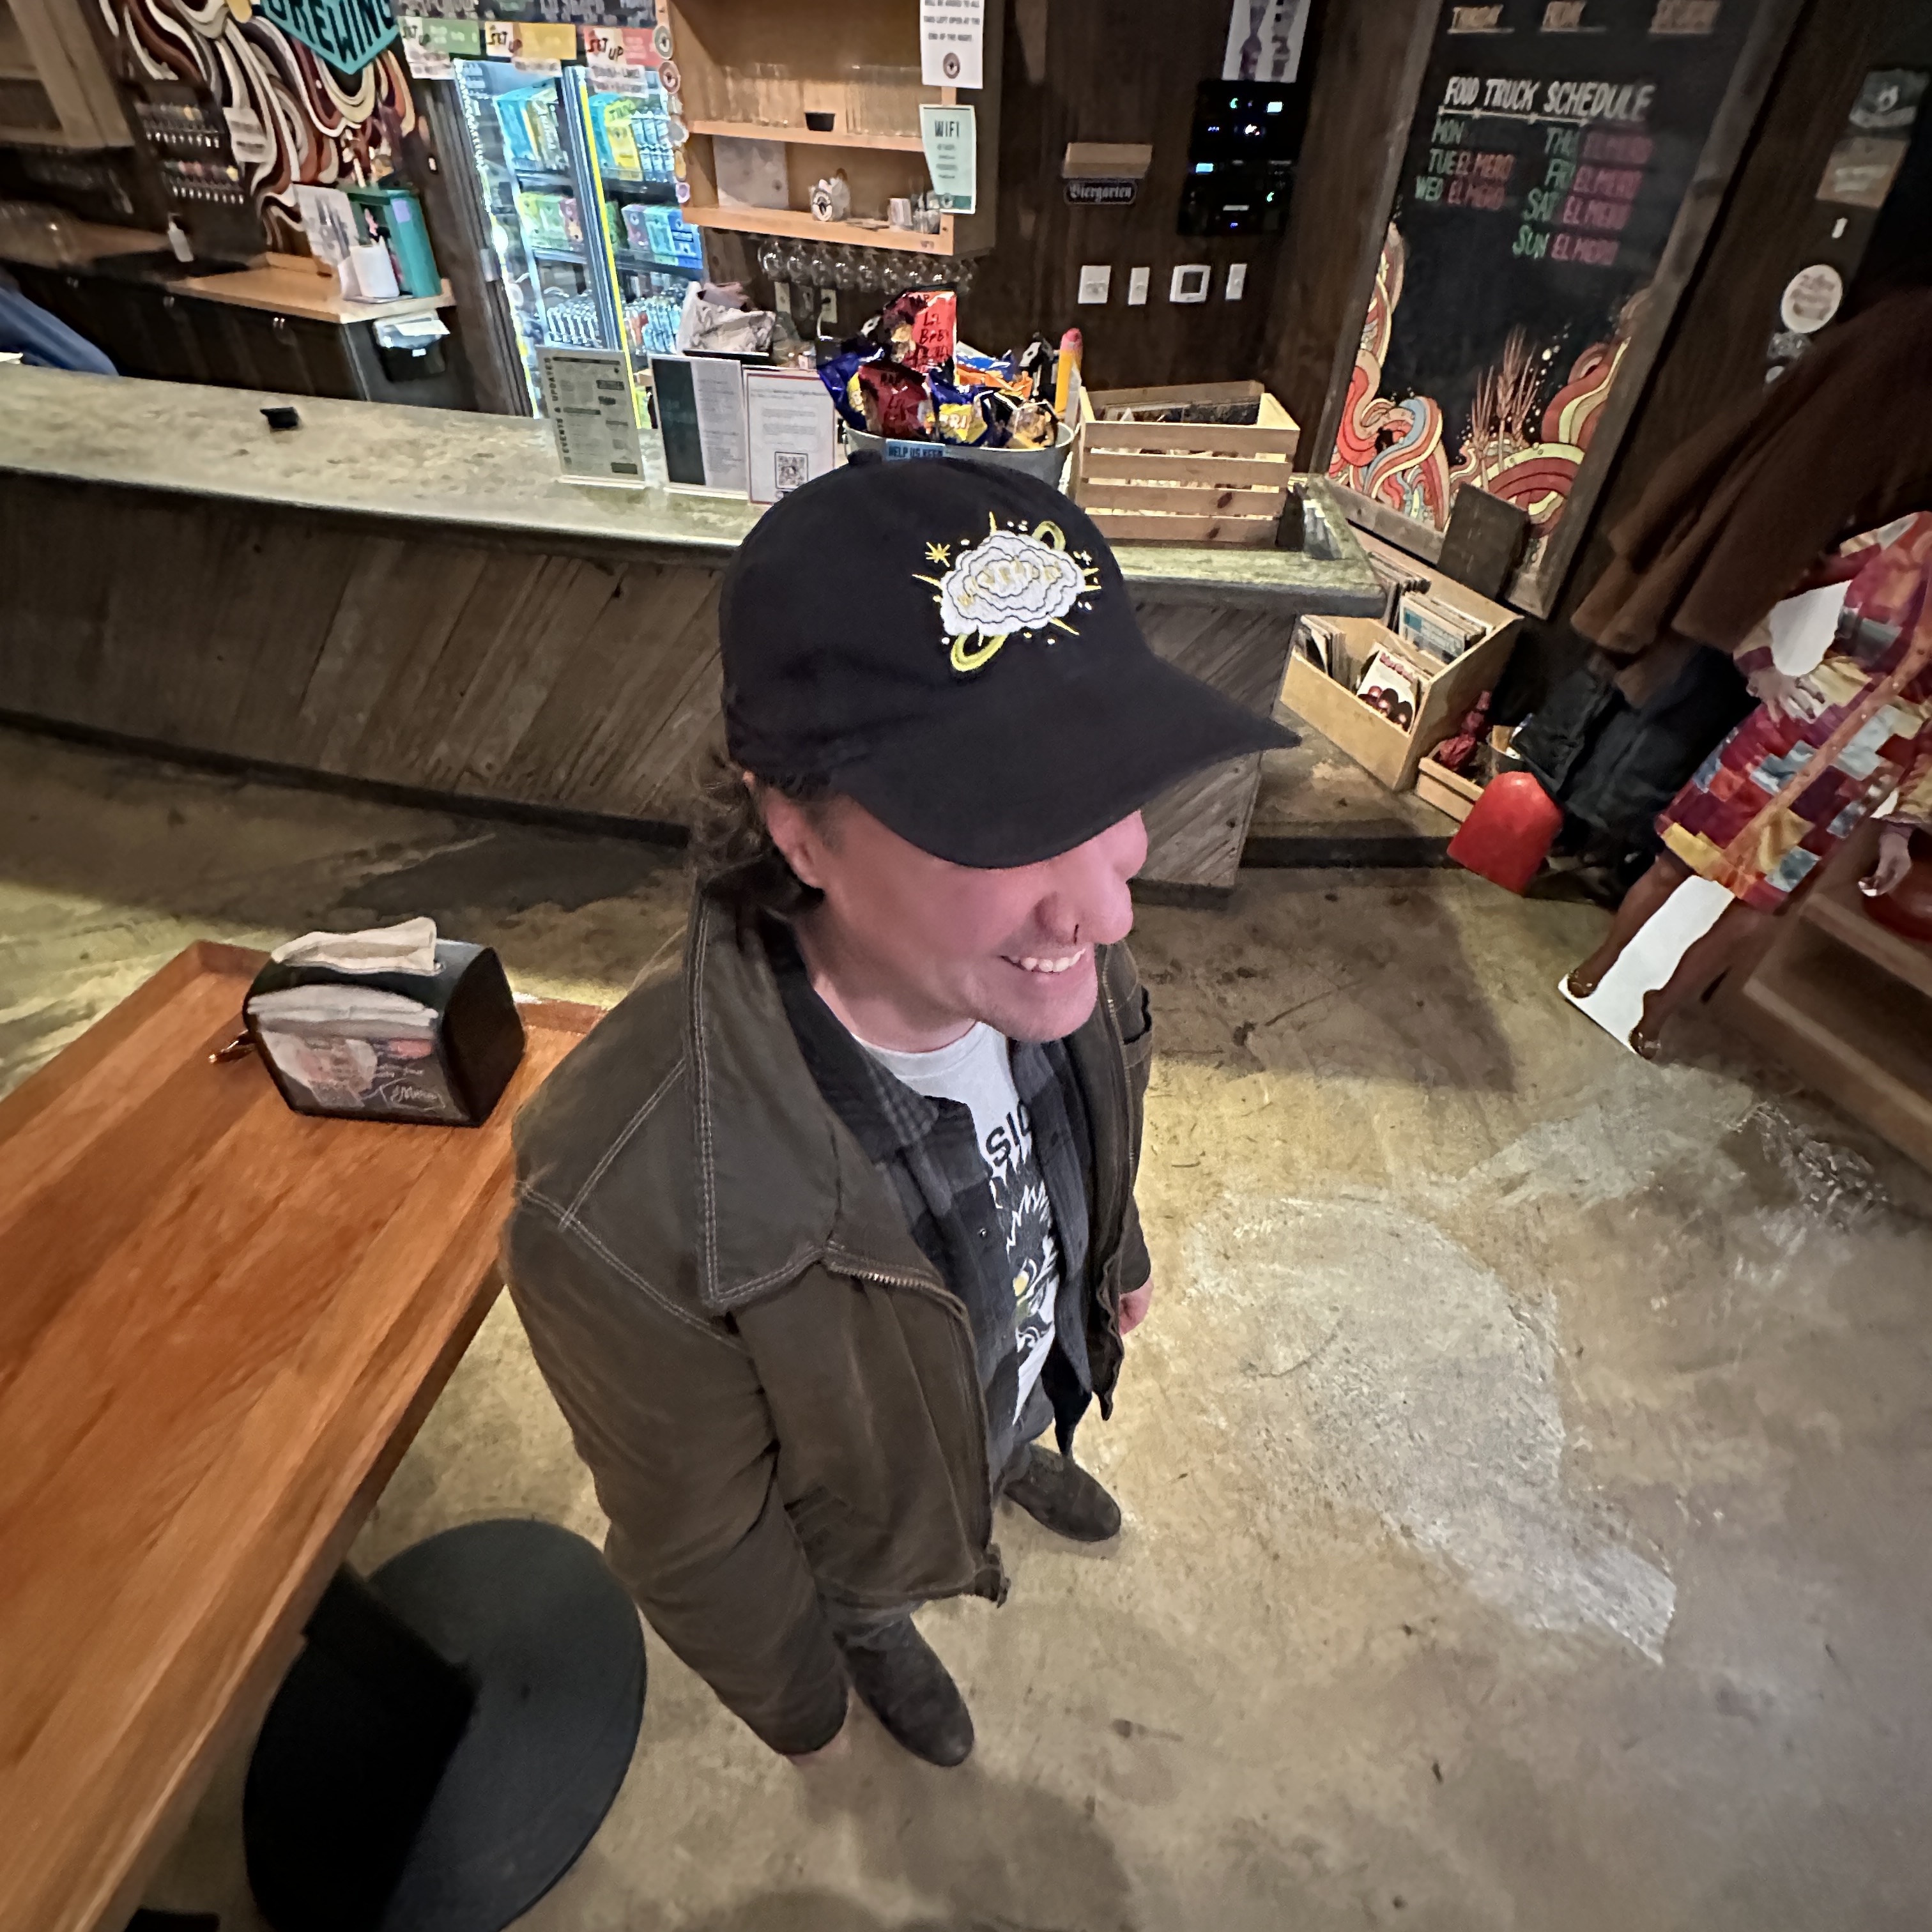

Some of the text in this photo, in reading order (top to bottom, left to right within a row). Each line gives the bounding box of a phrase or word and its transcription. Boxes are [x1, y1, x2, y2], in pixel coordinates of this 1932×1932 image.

[1444, 76, 1656, 121] FOOD TRUCK SCHEDULE
[1431, 117, 1464, 144] MON
[1429, 148, 1457, 175] TUE
[1512, 224, 1550, 260] SUN
